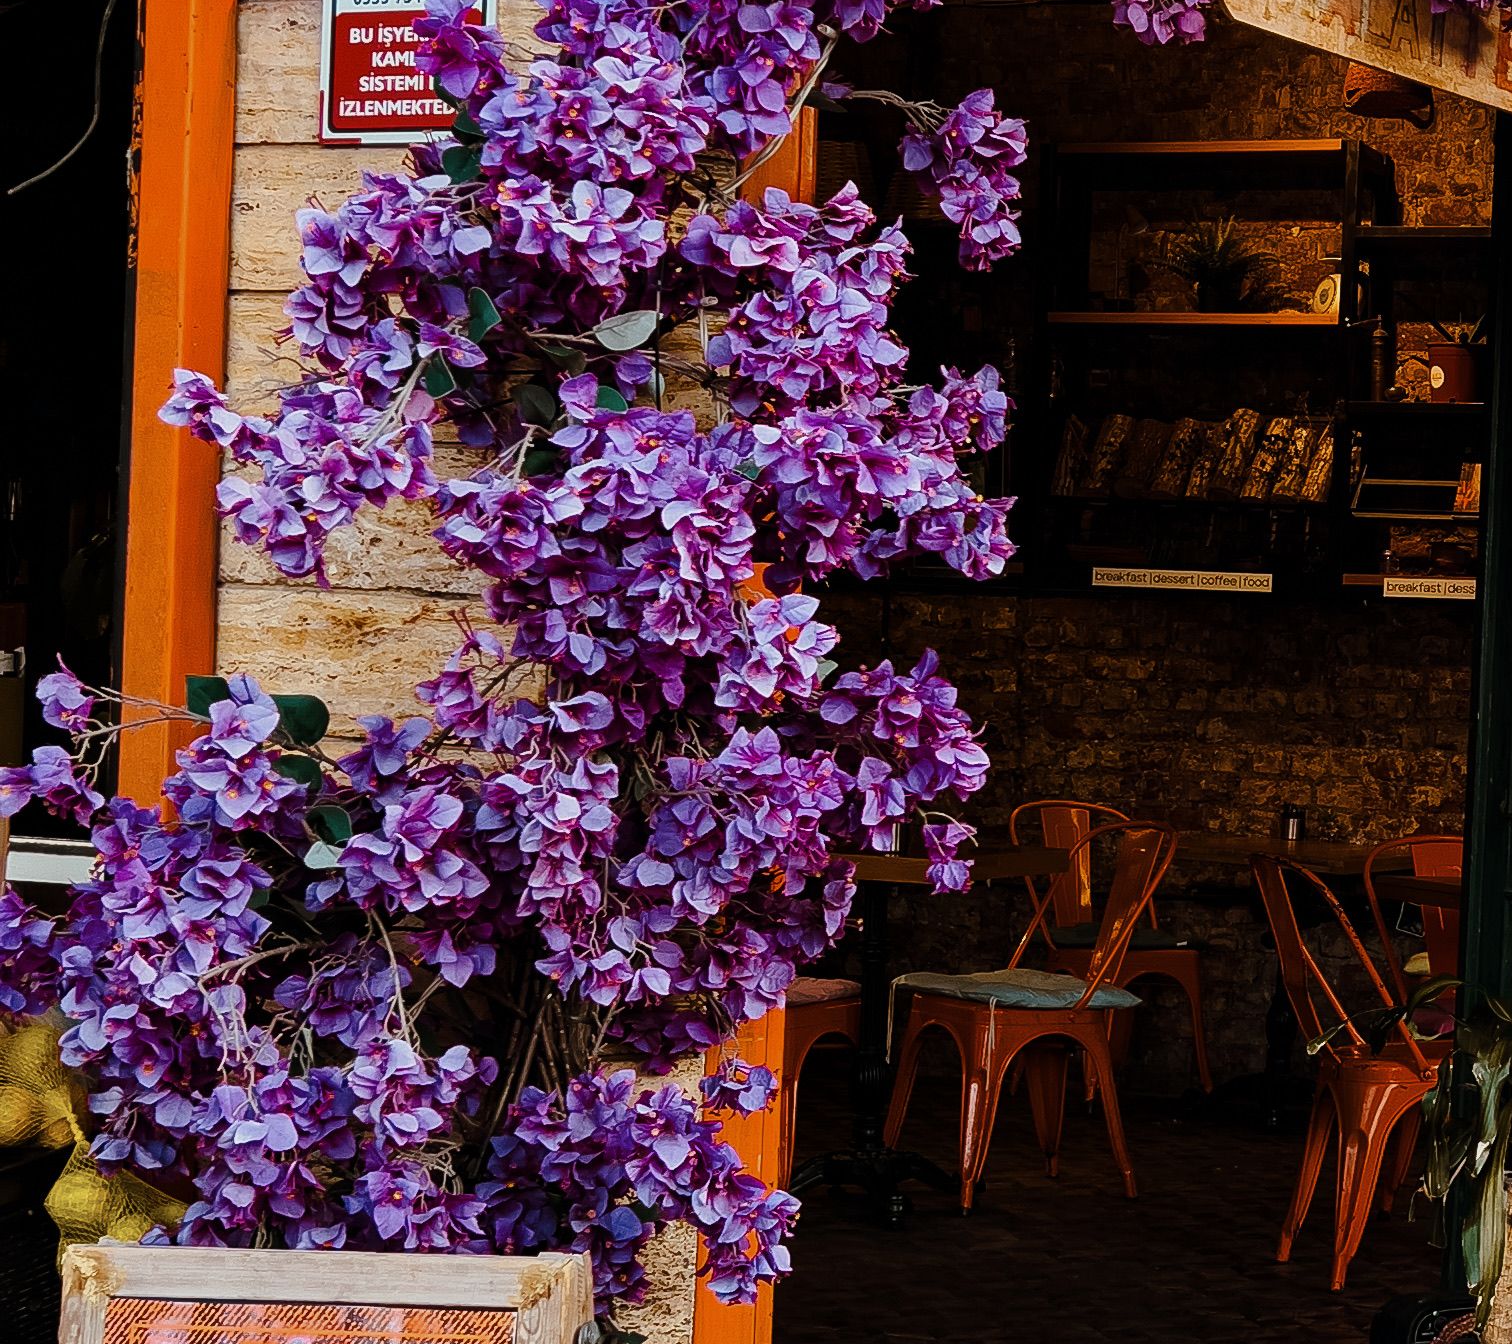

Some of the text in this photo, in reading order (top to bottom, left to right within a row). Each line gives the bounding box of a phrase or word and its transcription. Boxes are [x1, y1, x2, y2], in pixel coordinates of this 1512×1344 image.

[349, 23, 430, 48] BU İŞYE
[358, 71, 425, 92] SİSTEMİ
[339, 96, 456, 117] İZLENMEKTED
[1447, 582, 1475, 595] dess
